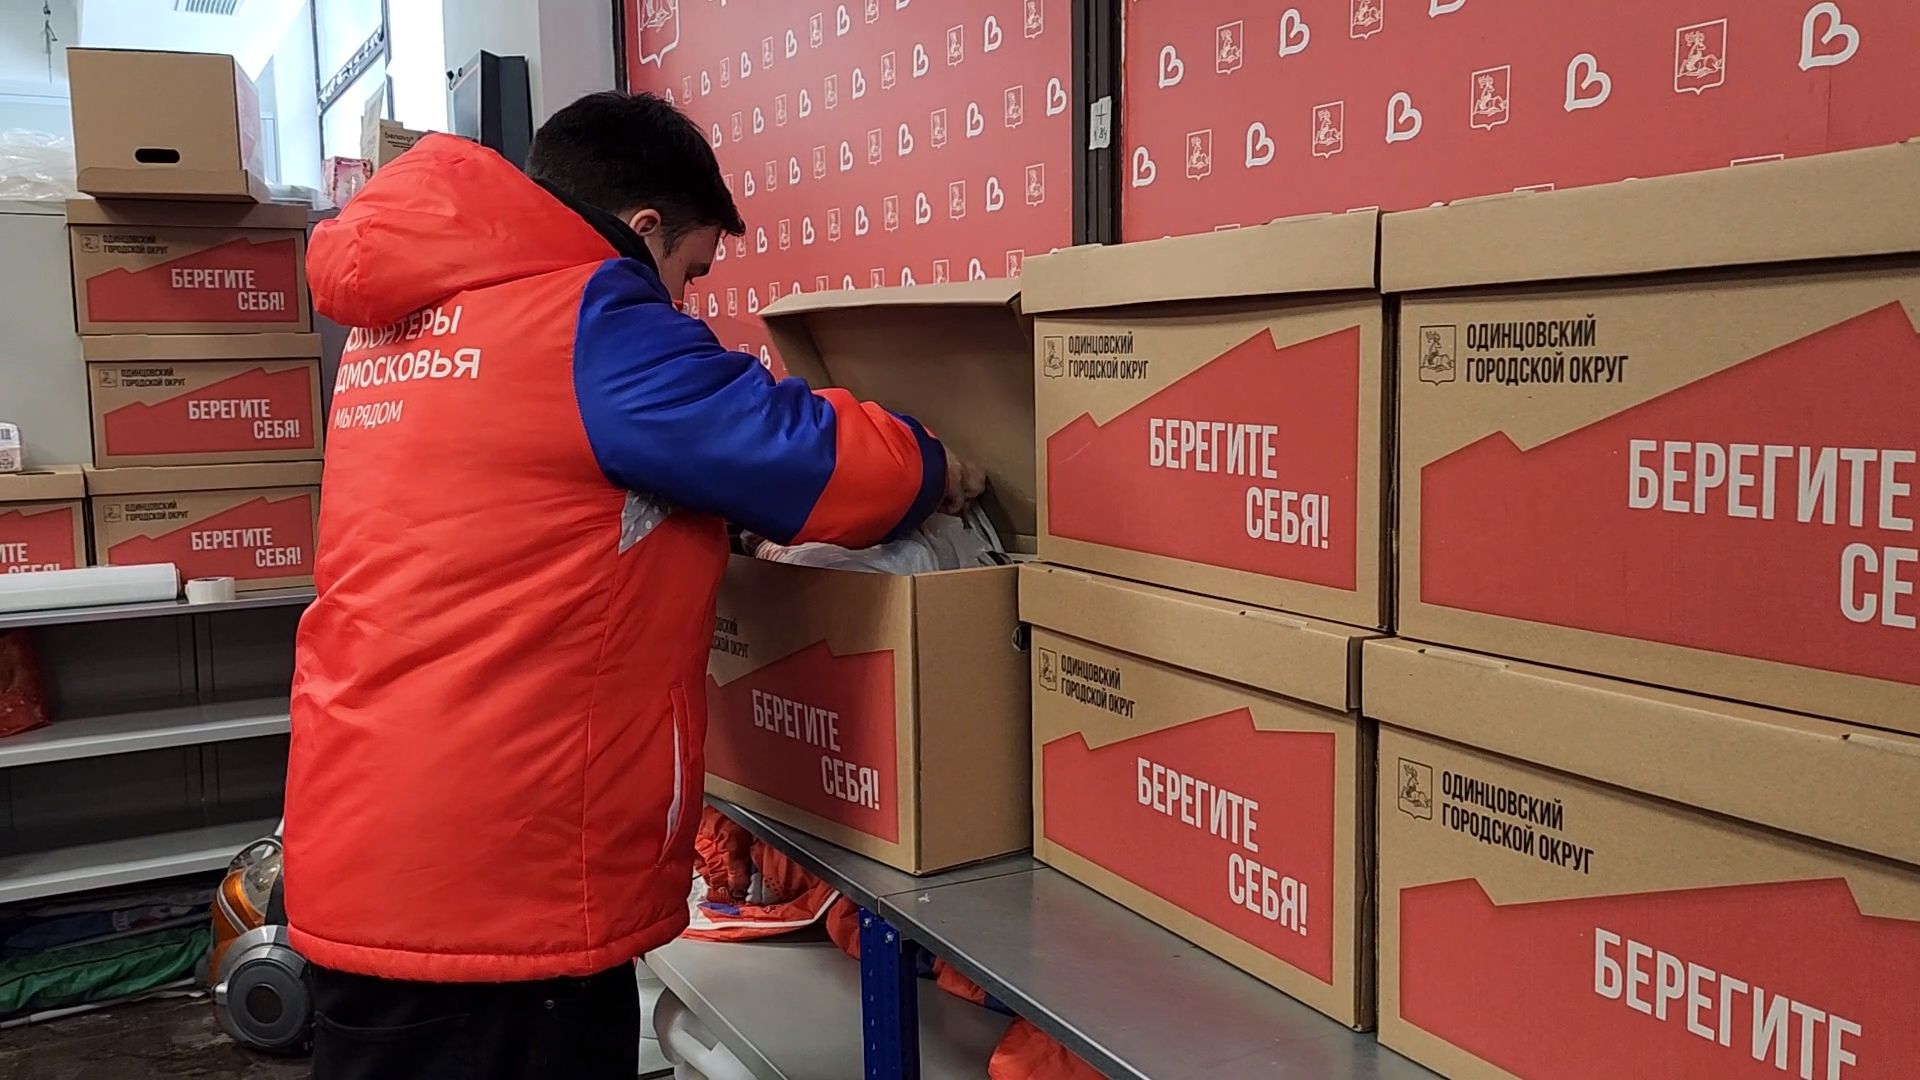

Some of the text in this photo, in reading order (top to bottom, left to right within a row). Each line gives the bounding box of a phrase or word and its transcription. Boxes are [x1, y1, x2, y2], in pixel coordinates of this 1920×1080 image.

[171, 268, 256, 288] БЕРЕГИТЕ
[238, 291, 285, 310] СЕБЯ!
[343, 305, 463, 353] ОЛОНТЕРЫ
[1068, 331, 1133, 356] ОДИНЦОВСКИЙ
[1466, 314, 1597, 354] ОДИНЦОВСКИЙ
[334, 348, 481, 395] ДМОСКОВЬЯ
[1068, 356, 1149, 380] ГОРОДСКОЙ ОКРУГ
[1466, 351, 1629, 387] ГОРОДСКОЙ ОКРУГ
[188, 399, 271, 420] БЕРЕГИТЕ
[253, 420, 300, 439] СЕБЯ!
[333, 399, 404, 431] МЫ РЯДОМ
[1149, 417, 1278, 479] БЕРЕГИТЕ
[1628, 439, 1917, 532] БЕРЕГИТЕ
[1245, 486, 1329, 549] СЕБЯ!
[191, 527, 273, 551] БЕРЕГИТЕ
[255, 547, 302, 568] СЕБЯ!
[1061, 654, 1121, 690] ОДИНЦОВСКИЙ
[1061, 679, 1136, 719] ГОРОДСКОЙ ОКРУГ
[752, 688, 841, 752] БЕРЕГИТЕ
[820, 755, 880, 811] СЕБЯ!
[1441, 770, 1564, 832] ОДИНЦОВСКИЙ
[1137, 756, 1259, 853] БЕРЕГИТЕ
[1441, 802, 1595, 876] ГОРОДСКОЙ ОКРУГ
[1227, 853, 1307, 937] СЕБЯ!
[1594, 927, 1862, 1080] БЕРЕГИТЕ
